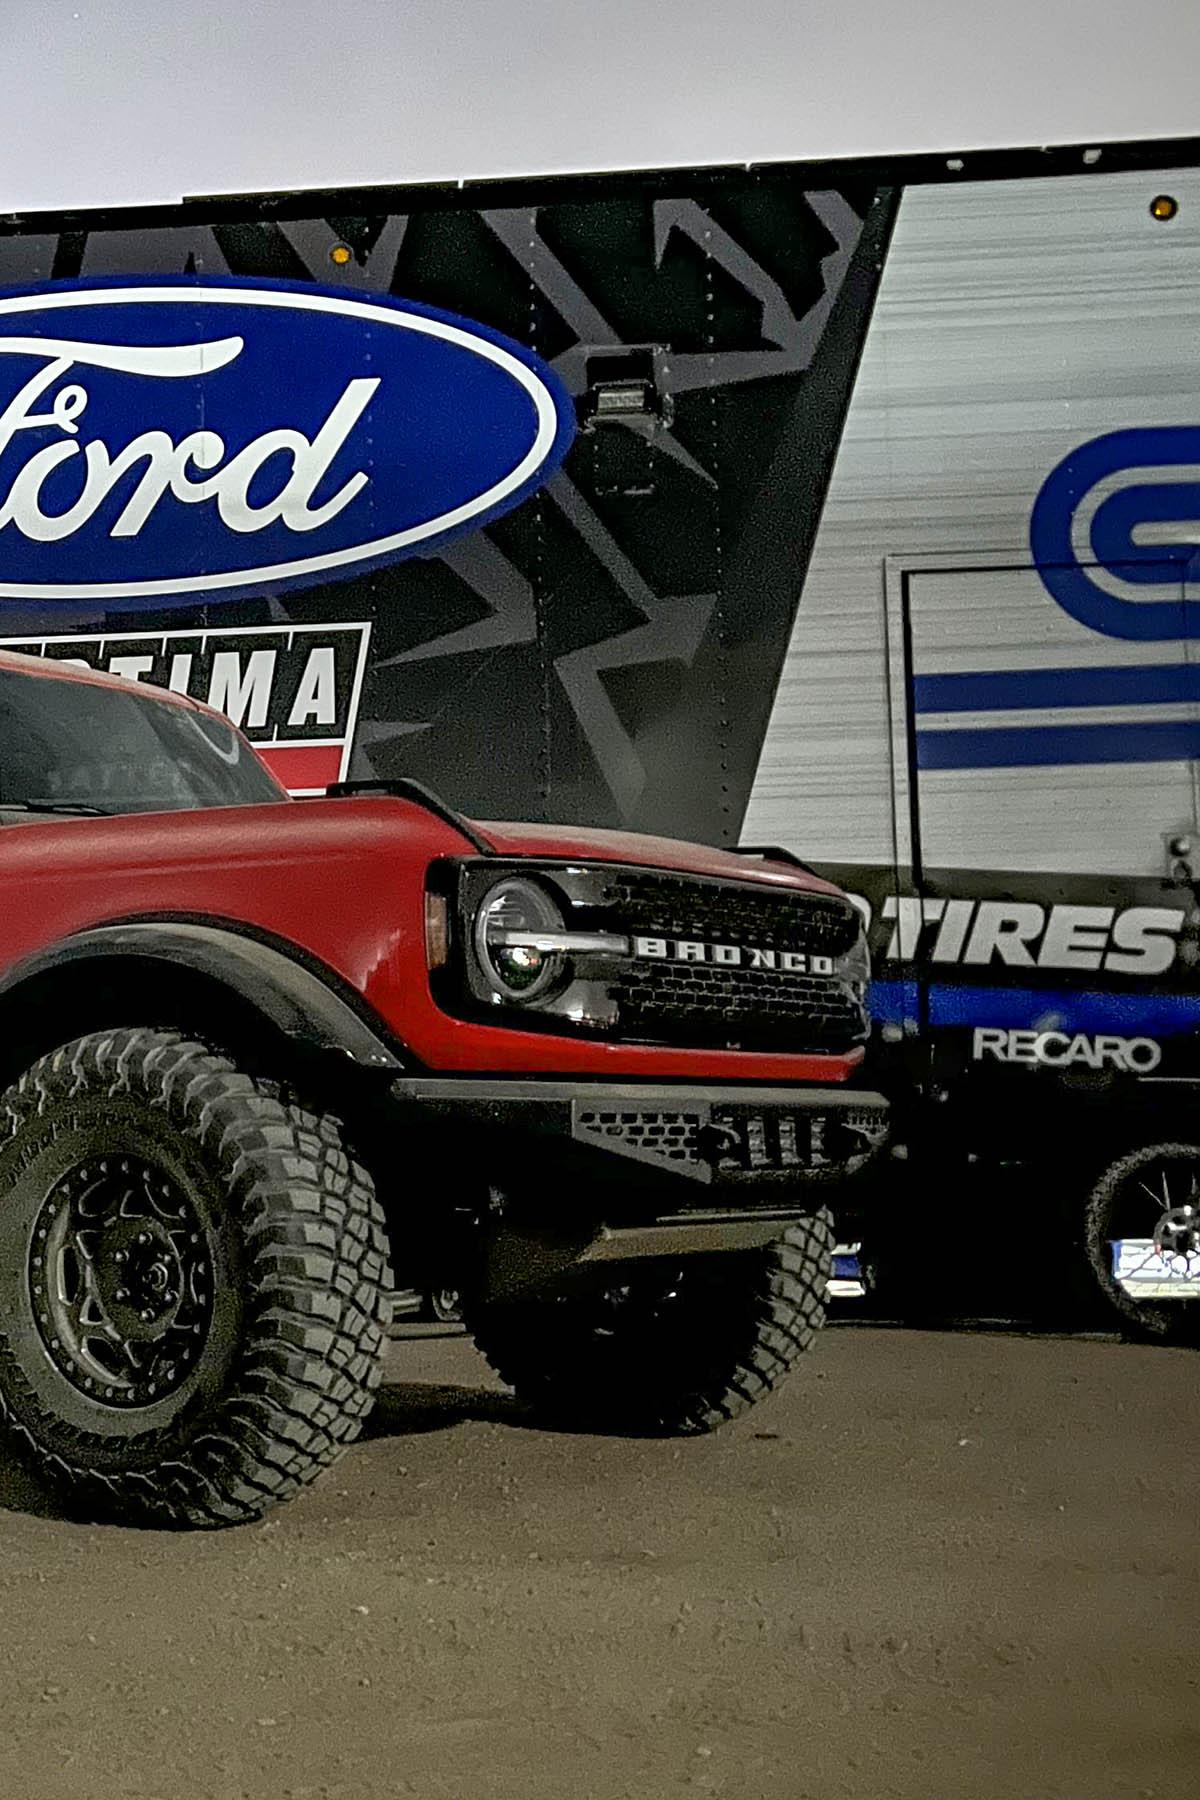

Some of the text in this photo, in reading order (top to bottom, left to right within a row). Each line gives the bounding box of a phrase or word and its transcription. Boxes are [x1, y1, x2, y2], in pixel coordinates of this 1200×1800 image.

[636, 936, 834, 975] BRONCO
[881, 896, 1186, 975] TIRES
[973, 1026, 1162, 1073] RECARO
